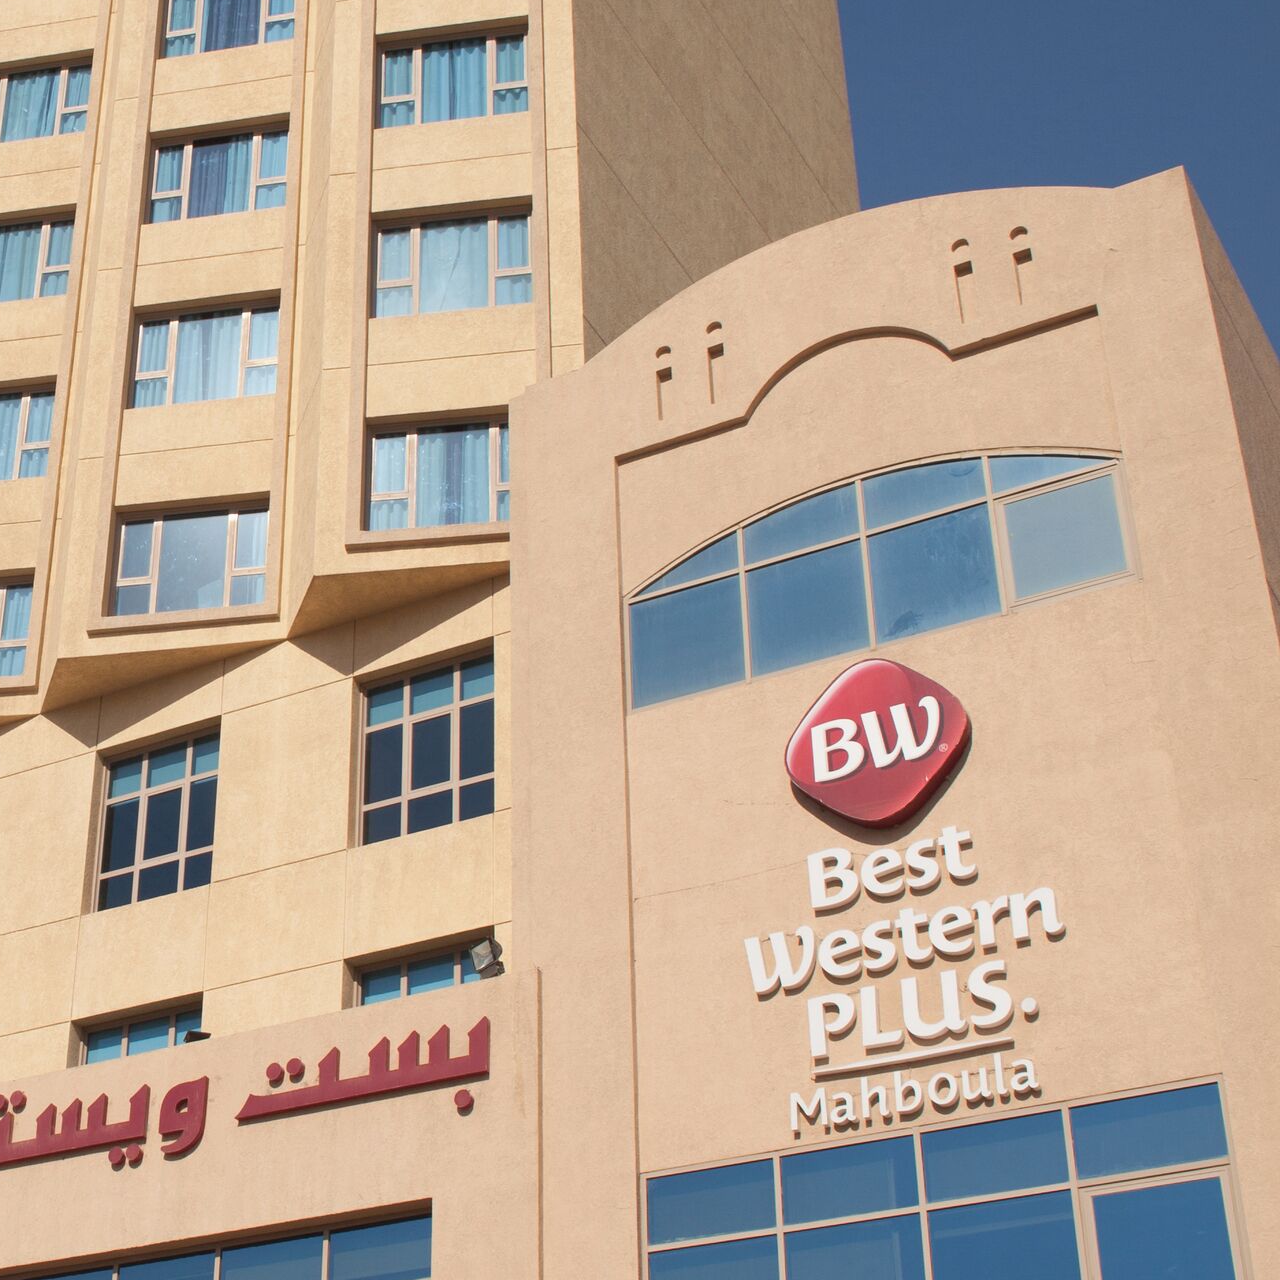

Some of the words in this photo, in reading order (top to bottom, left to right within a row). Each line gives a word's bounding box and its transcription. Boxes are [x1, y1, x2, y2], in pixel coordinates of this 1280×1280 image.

[810, 695, 941, 783] BW
[807, 825, 978, 911] Best
[744, 887, 1065, 996] Western
[235, 1016, 490, 1123] بست
[789, 1053, 1040, 1134] Mahboula
